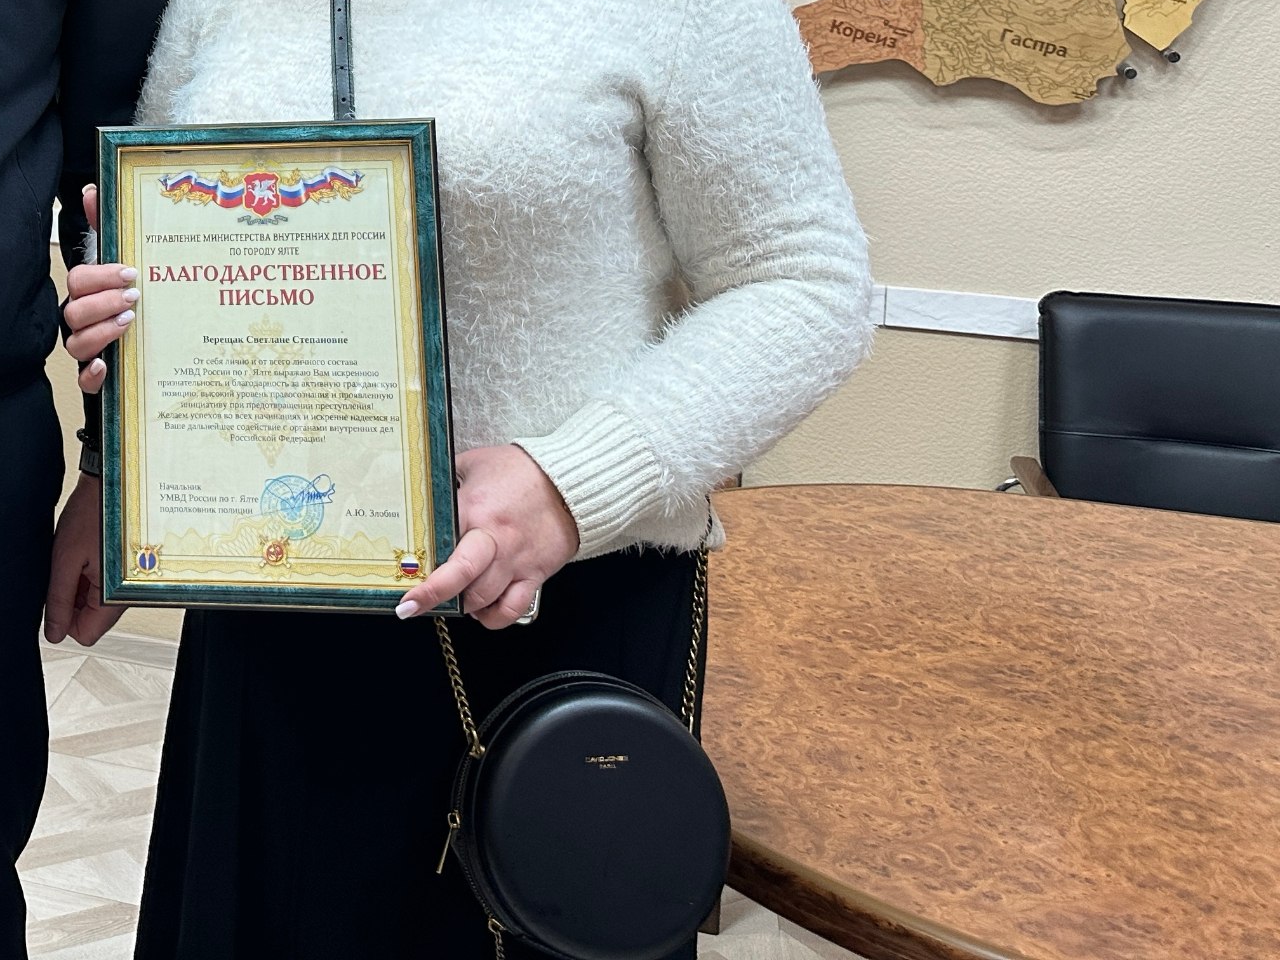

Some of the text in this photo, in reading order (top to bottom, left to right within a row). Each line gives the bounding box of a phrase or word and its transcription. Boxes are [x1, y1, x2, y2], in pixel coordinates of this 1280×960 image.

[830, 19, 898, 49] Кореиз
[1000, 28, 1068, 58] Гаспра
[146, 232, 386, 243] УПРАВЛЕНИЕ МИНИСТЕРСТВА ВНУТРЕННИХ ДЕЛ РОССИИ
[244, 247, 275, 256] ГОРОДУ
[278, 247, 299, 255] ЯЛТЕ
[149, 264, 387, 284] БЛАГОДАРСТВЕННОЕ
[219, 289, 314, 306] ПИСЬМО
[203, 336, 244, 345] Верещак
[292, 336, 348, 344] Степановне
[174, 368, 201, 377] УМВД
[313, 369, 329, 377] Вам
[160, 494, 187, 503] УМВД
